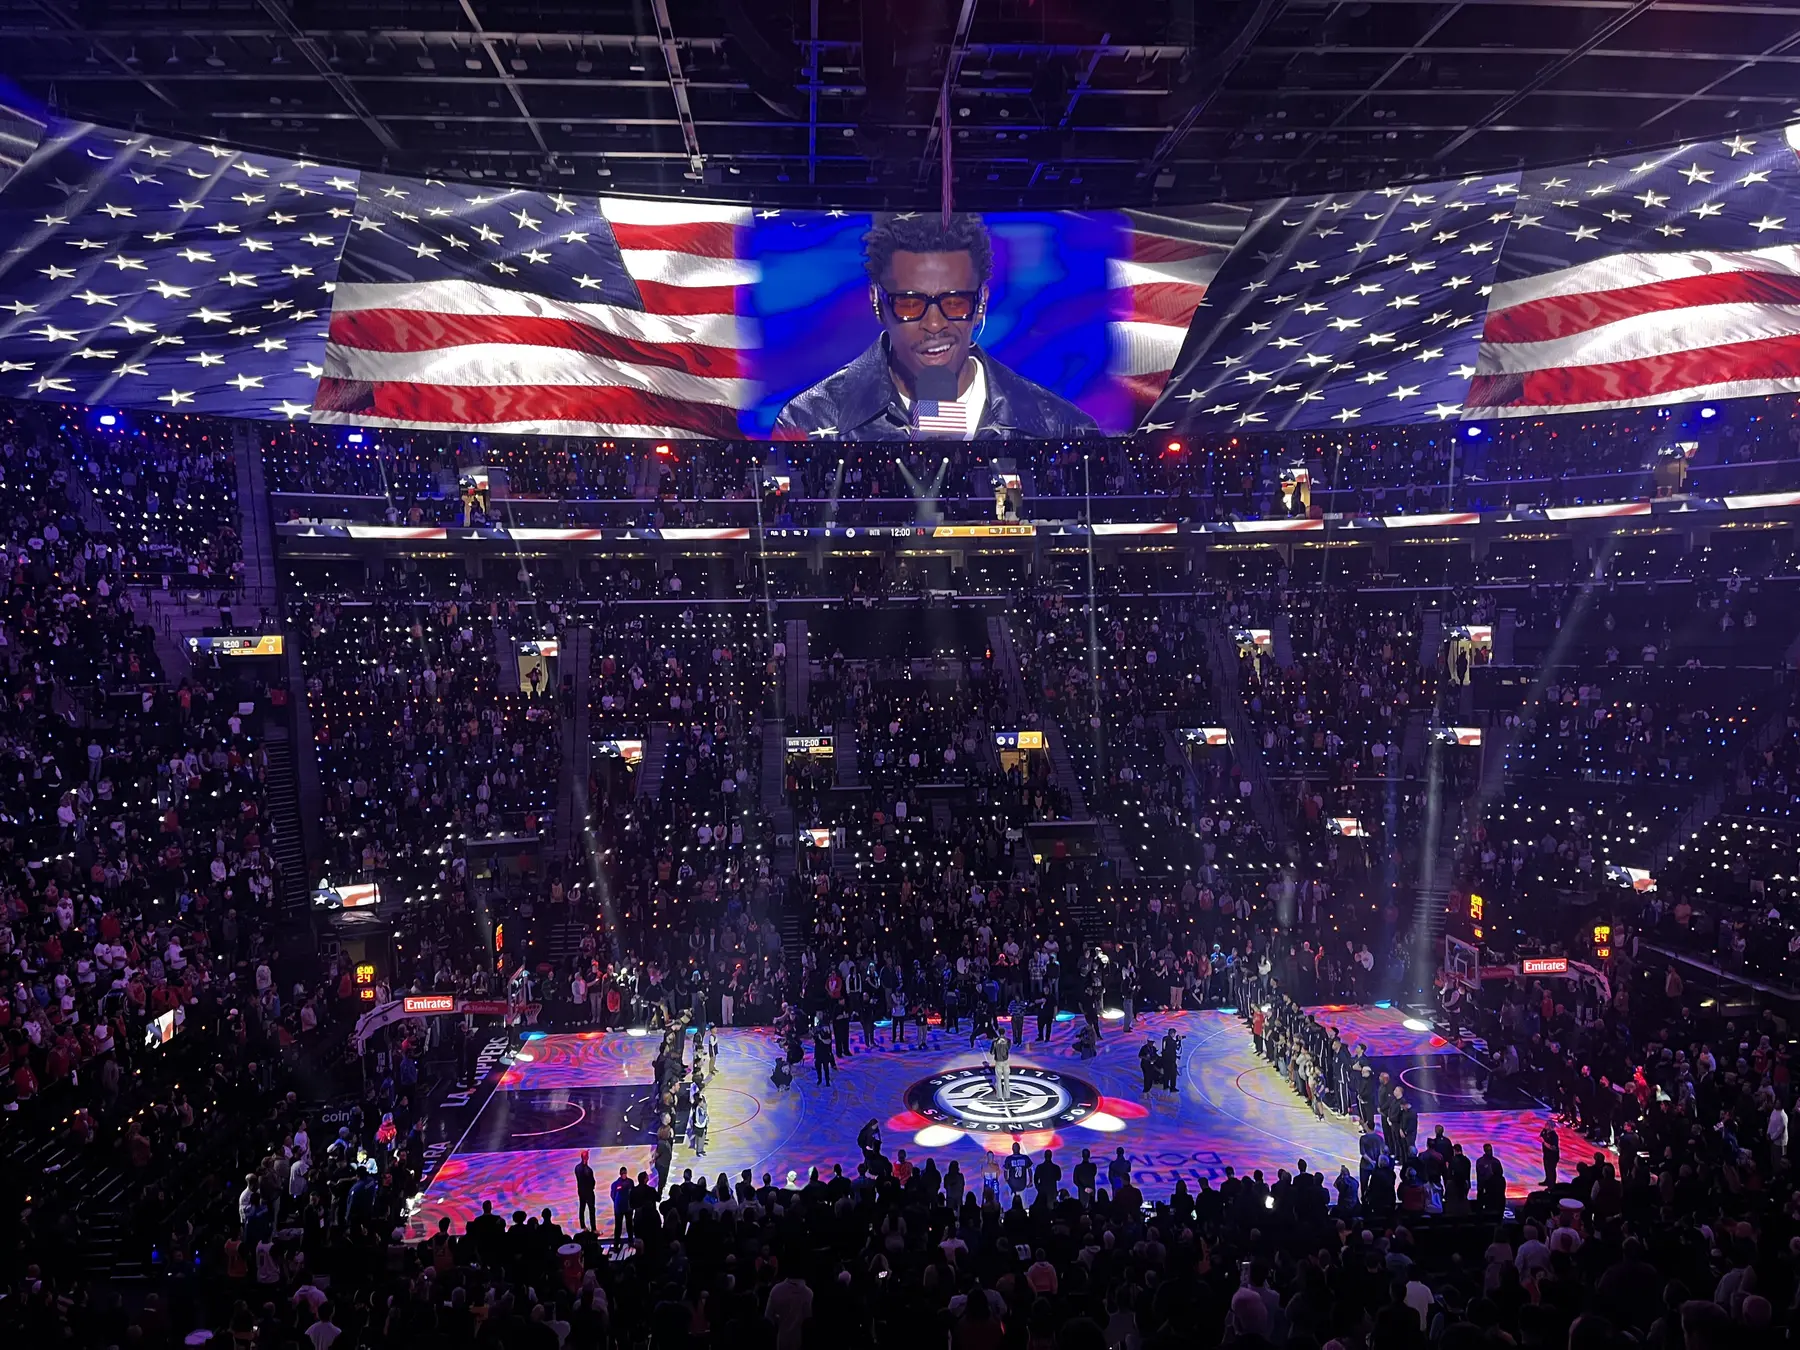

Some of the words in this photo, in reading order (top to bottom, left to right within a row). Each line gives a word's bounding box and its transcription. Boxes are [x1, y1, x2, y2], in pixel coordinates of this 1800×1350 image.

[803, 529, 809, 537] 7
[825, 529, 831, 537] 0
[890, 528, 911, 537] 12:00
[223, 640, 240, 648] 12:00
[800, 739, 819, 747] 12:00
[1008, 737, 1015, 745] 0
[1594, 934, 1607, 943] 24
[1525, 961, 1566, 972] Emirates
[356, 974, 371, 983] 24
[406, 998, 451, 1010] Emirates
[929, 1069, 1061, 1086] CLIPERS
[322, 1109, 352, 1123] coin
[1059, 1102, 1092, 1122] LOS
[923, 1108, 1045, 1132] ANGELES
